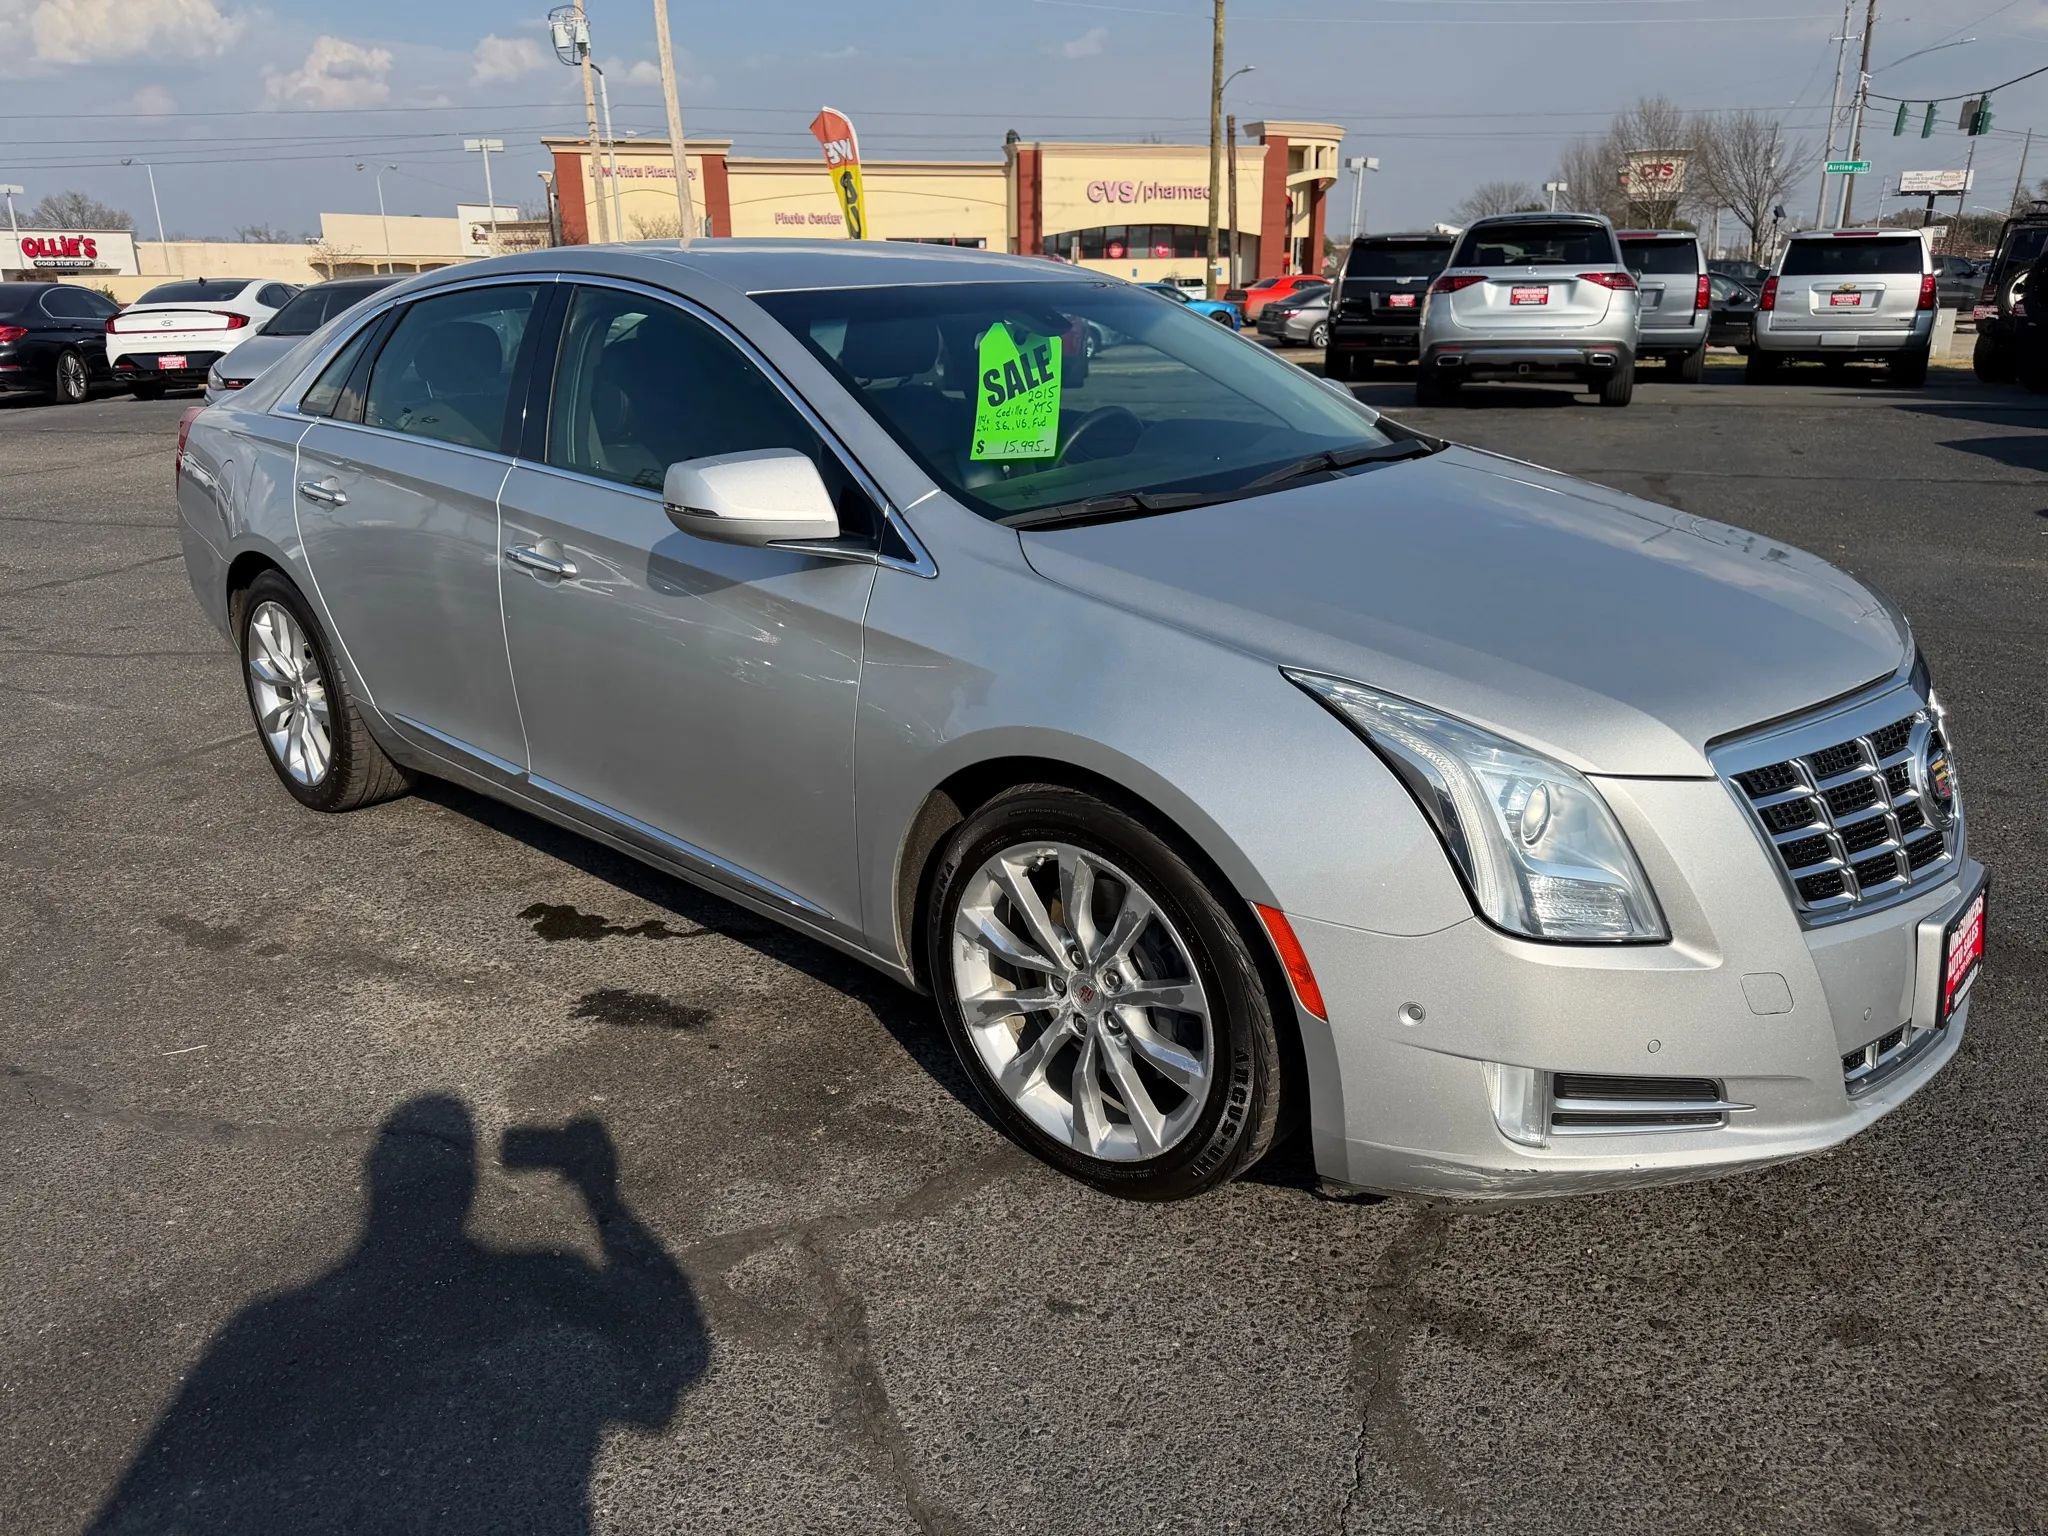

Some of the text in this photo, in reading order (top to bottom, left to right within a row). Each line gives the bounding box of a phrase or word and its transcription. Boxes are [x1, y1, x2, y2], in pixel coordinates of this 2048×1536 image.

[645, 165, 698, 181] Pharmy
[1087, 181, 1211, 203] CVS/pharmac
[774, 212, 842, 225] Photo Center
[983, 344, 1055, 407] SALE
[1028, 385, 1058, 403] 2015
[1032, 400, 1053, 415] XTS
[975, 440, 985, 455] $
[1949, 894, 1984, 958] ONSUMERS
[1947, 943, 1964, 981] AUTO
[1963, 919, 1979, 956] SALES
